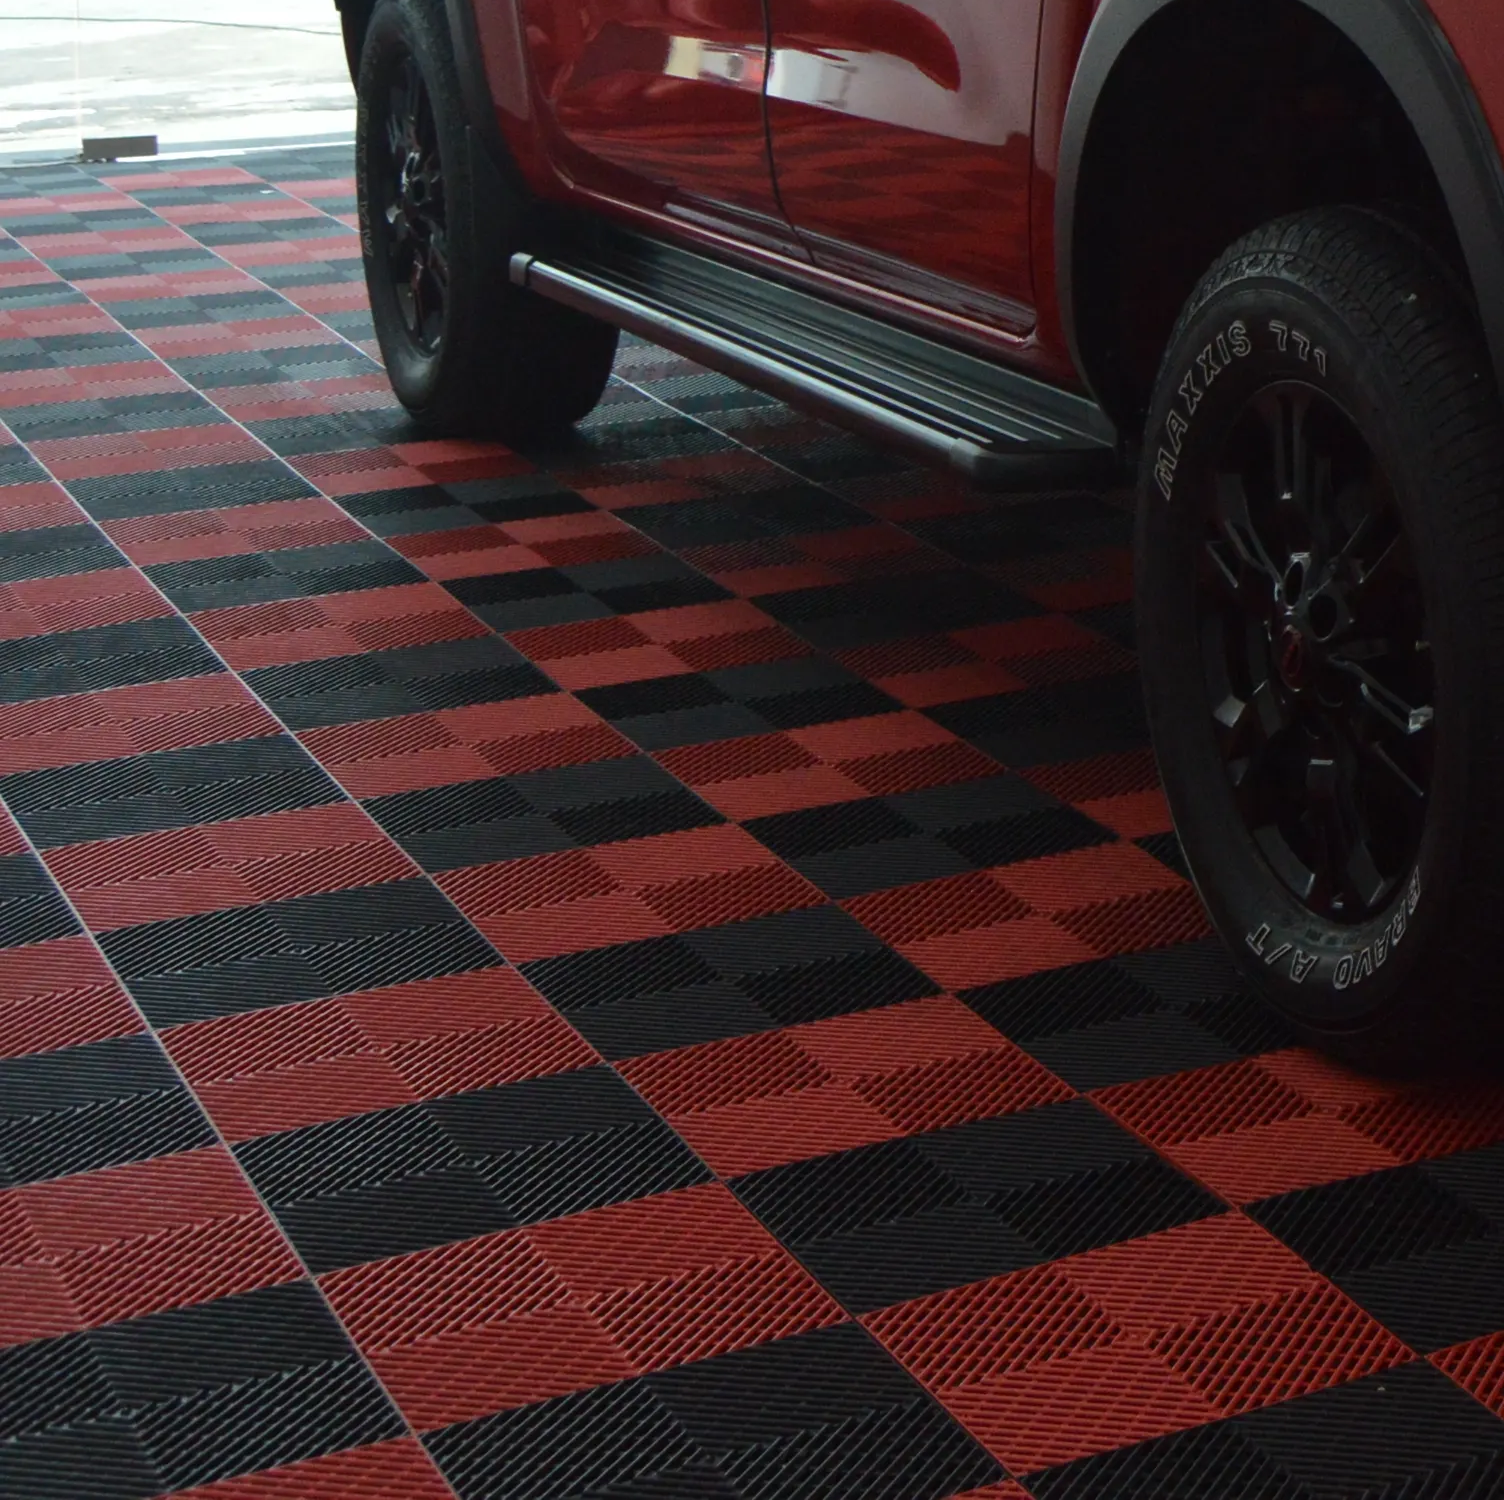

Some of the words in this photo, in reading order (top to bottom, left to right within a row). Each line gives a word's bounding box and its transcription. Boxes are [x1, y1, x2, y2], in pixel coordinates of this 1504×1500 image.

[1153, 319, 1253, 502] MAXXIS
[1268, 319, 1329, 378] 771
[1245, 922, 1318, 985] A/T
[1332, 864, 1422, 991] BRAVO
